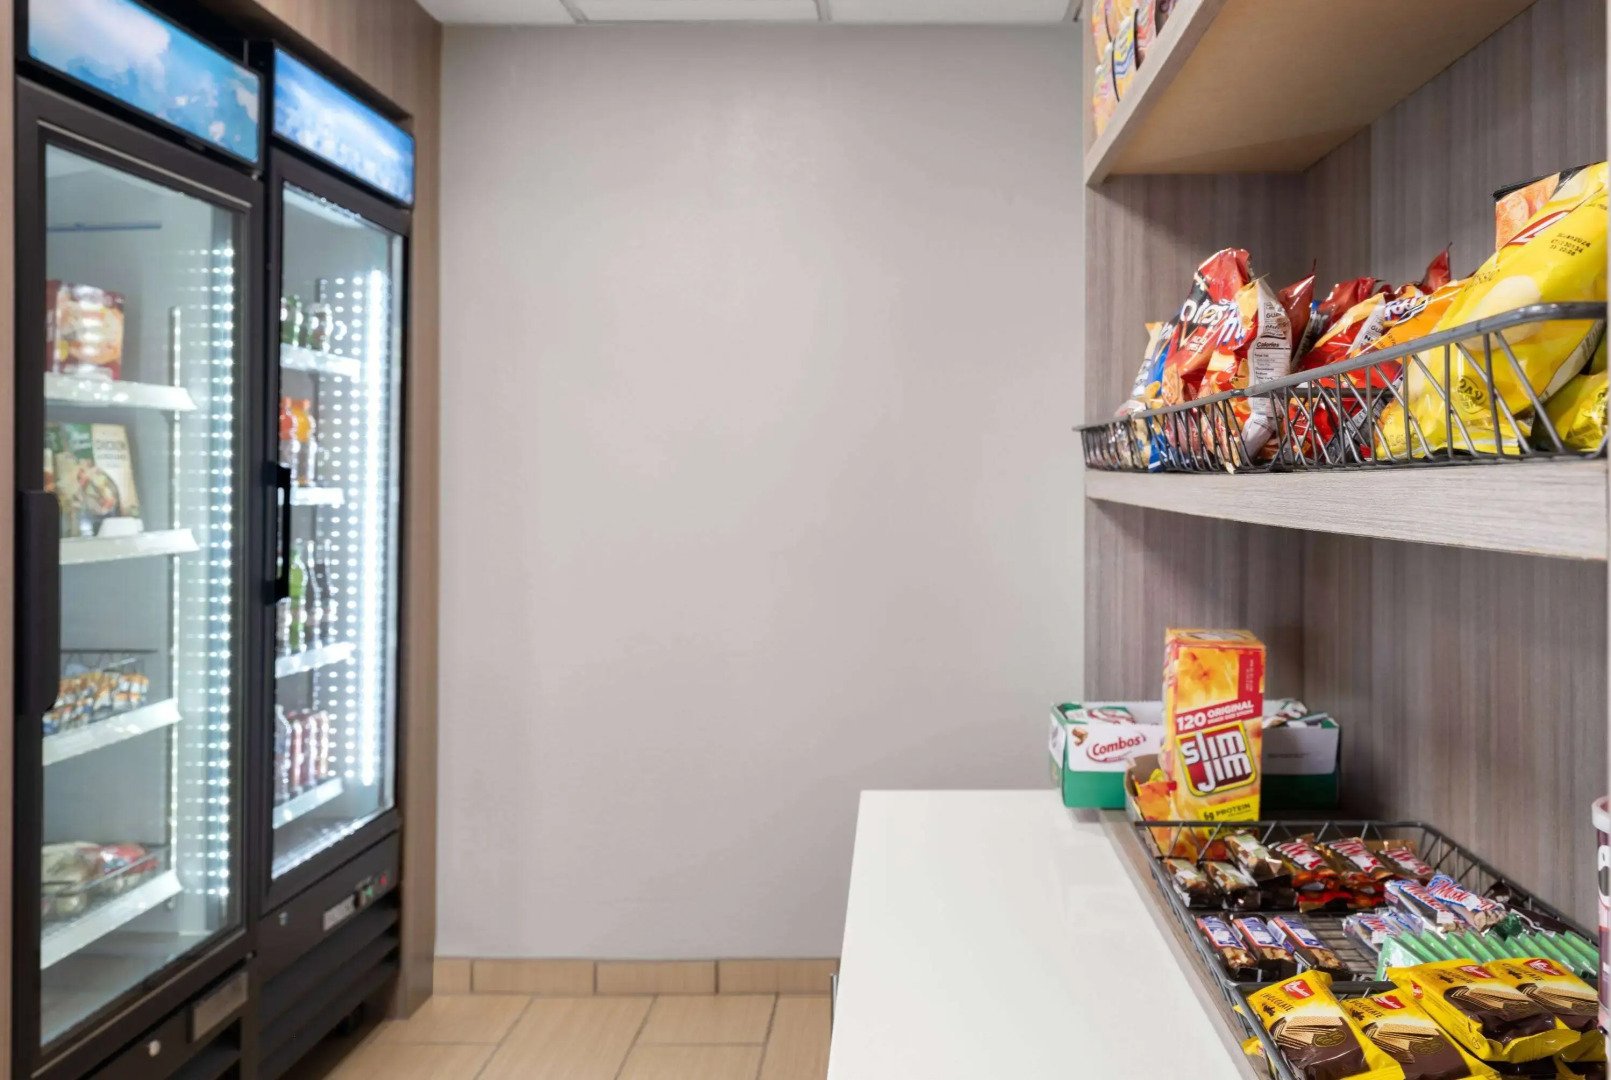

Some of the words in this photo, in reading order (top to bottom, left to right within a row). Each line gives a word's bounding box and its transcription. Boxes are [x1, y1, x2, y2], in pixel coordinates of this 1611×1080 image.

[1176, 712, 1207, 731] 120
[1207, 700, 1254, 718] ORIGINAL
[1092, 736, 1141, 756] Combos
[1181, 731, 1247, 766] slim
[1197, 752, 1252, 793] jim
[1215, 803, 1251, 816] PROTEIN
